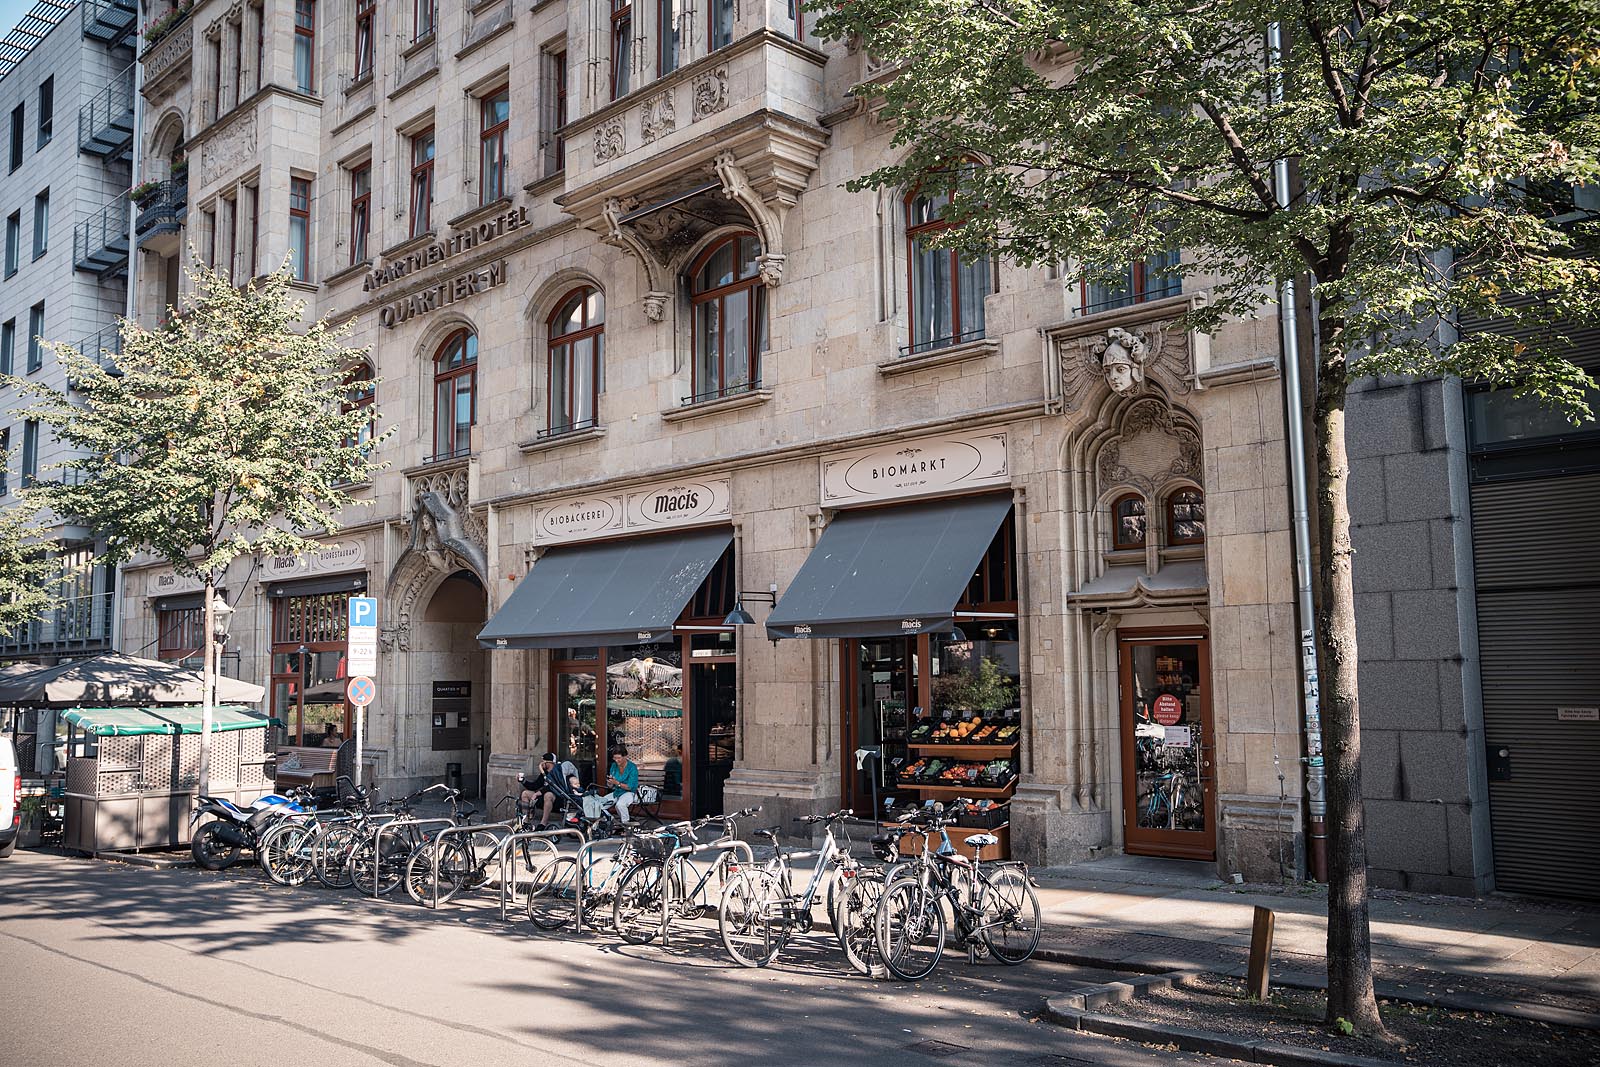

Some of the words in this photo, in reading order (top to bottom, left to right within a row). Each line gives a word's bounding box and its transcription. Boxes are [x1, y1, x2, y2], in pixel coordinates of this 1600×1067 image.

[363, 206, 531, 292] APARTMENTHOTEL
[872, 458, 946, 480] BIOMARKT
[654, 489, 699, 514] macis
[273, 553, 295, 569] macis
[320, 547, 358, 561] BIORESTAURANT
[355, 601, 371, 624] P
[901, 618, 922, 629] macis
